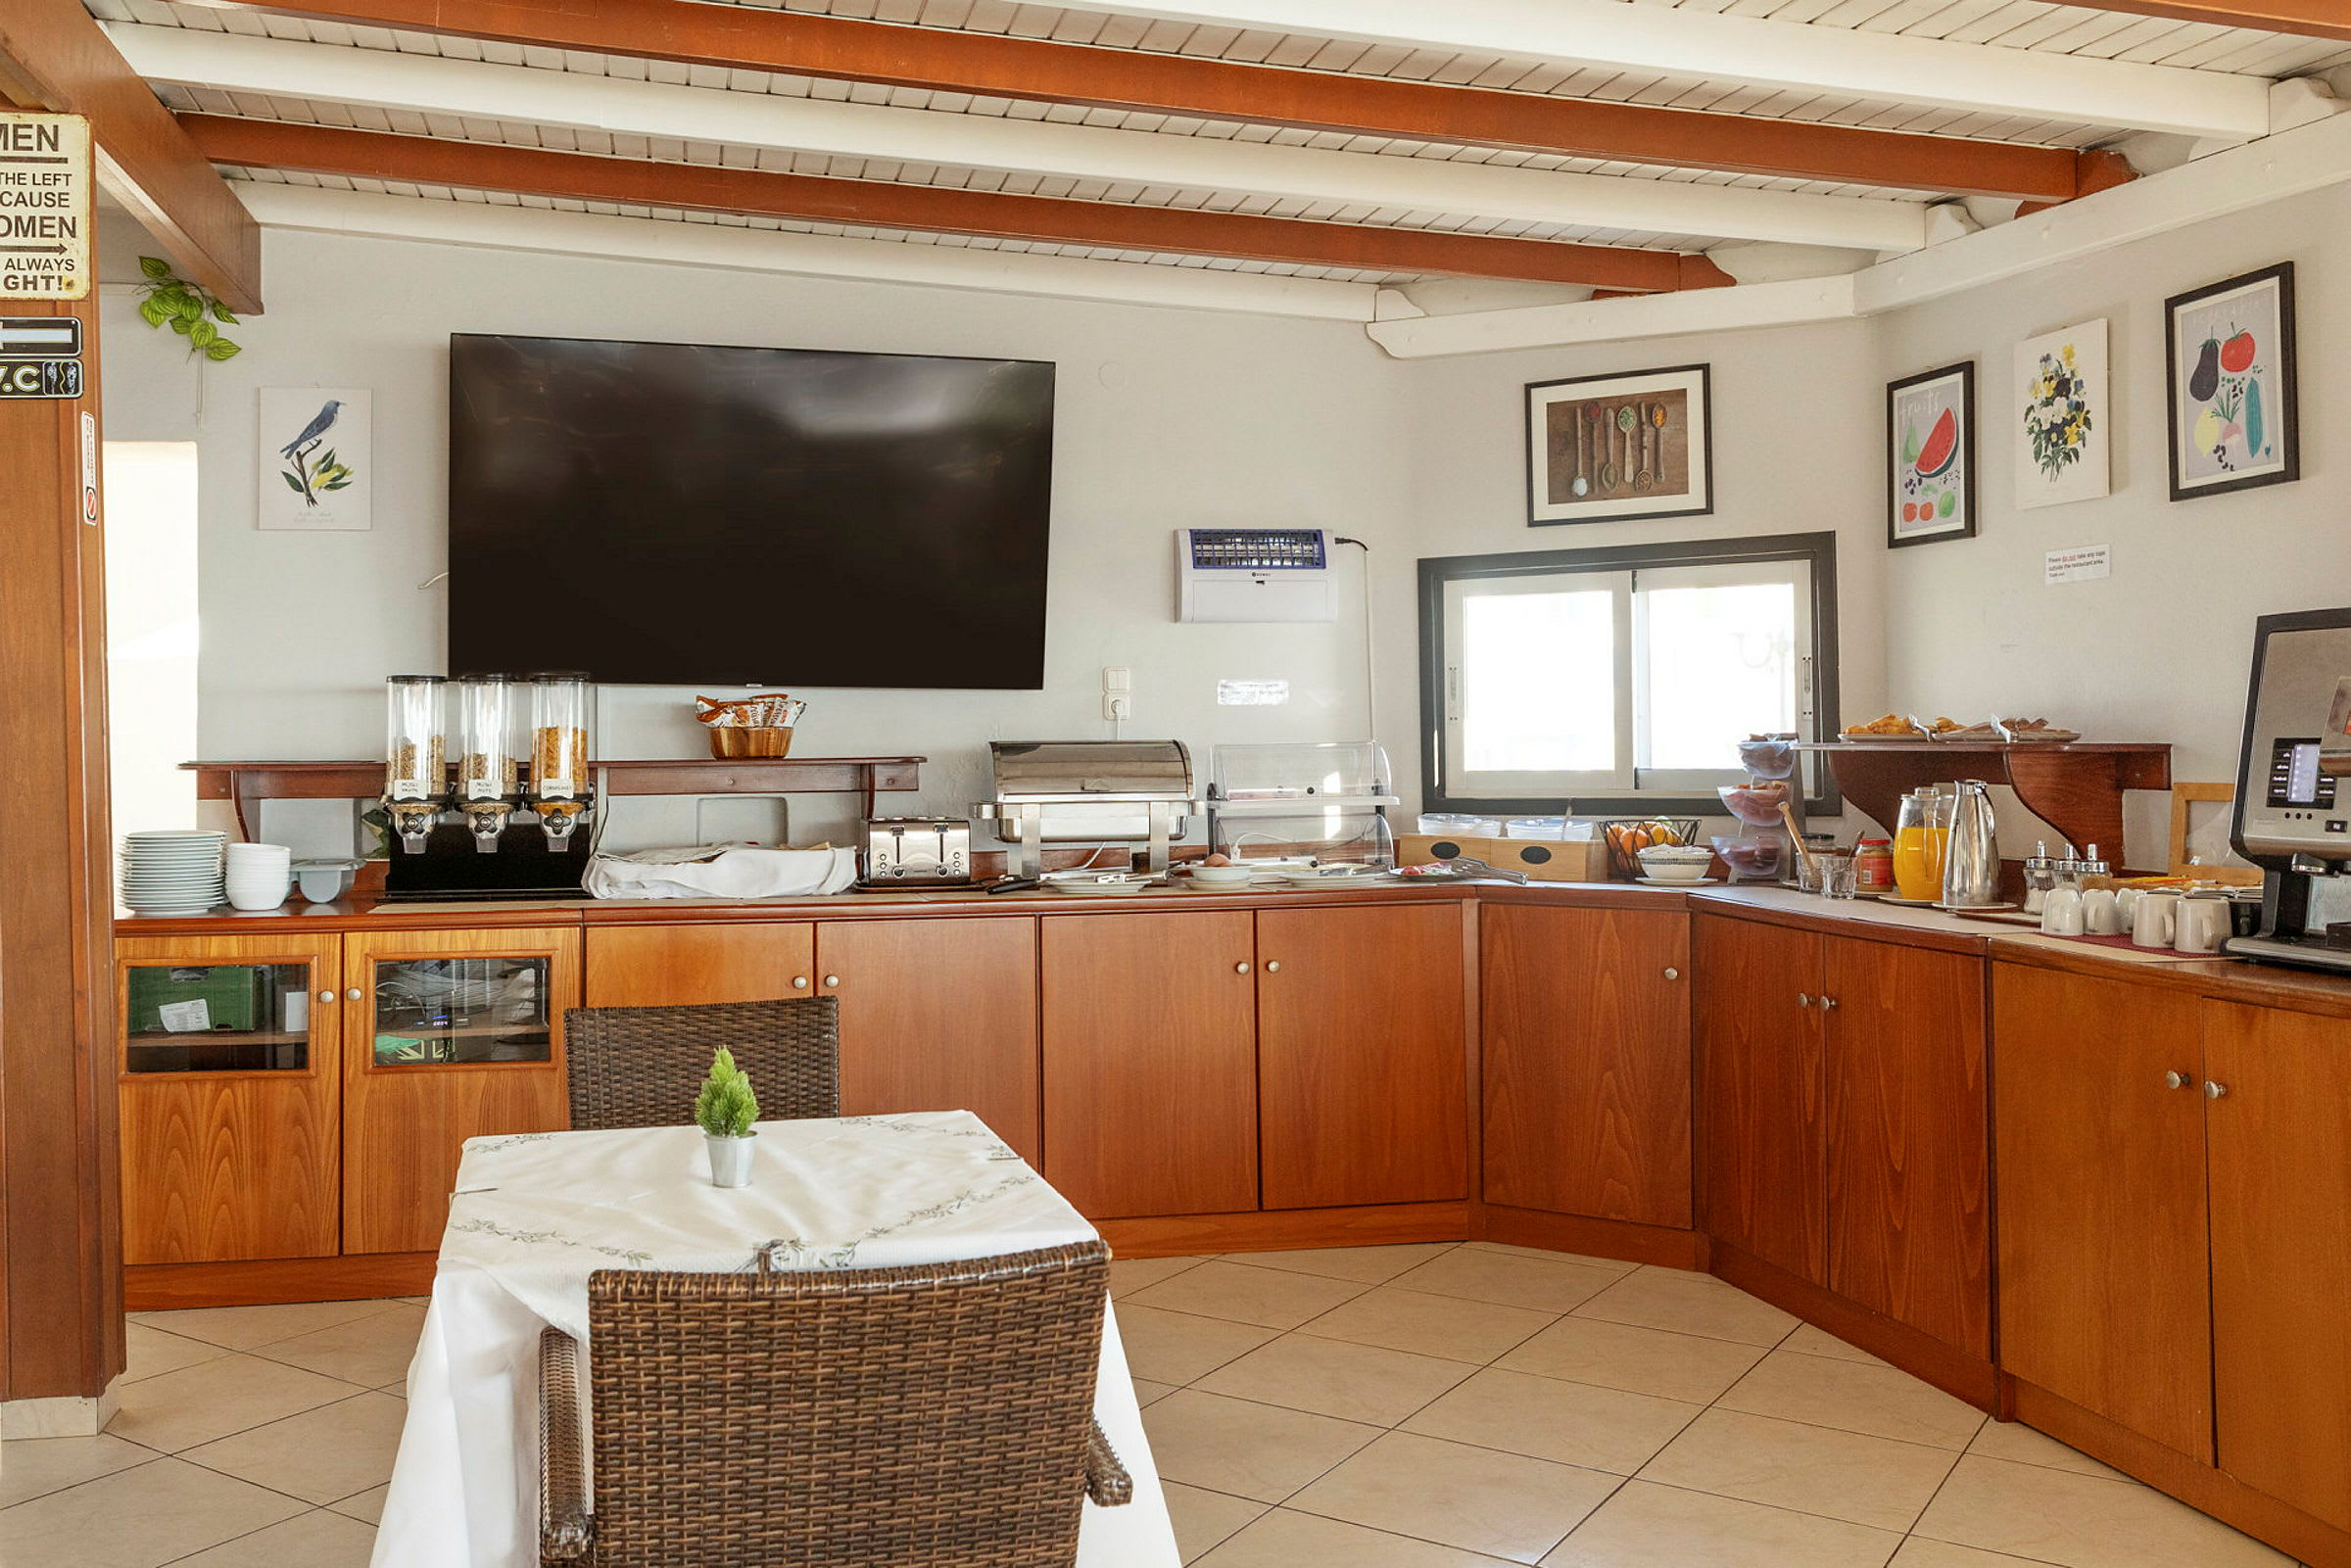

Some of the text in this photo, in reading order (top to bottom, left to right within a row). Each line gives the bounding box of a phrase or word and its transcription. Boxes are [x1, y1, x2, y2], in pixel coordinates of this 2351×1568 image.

[32, 172, 73, 187] LEFT
[0, 190, 72, 209] CAUSE
[4, 257, 75, 272] ALWAYS
[3, 274, 65, 292] GHT!
